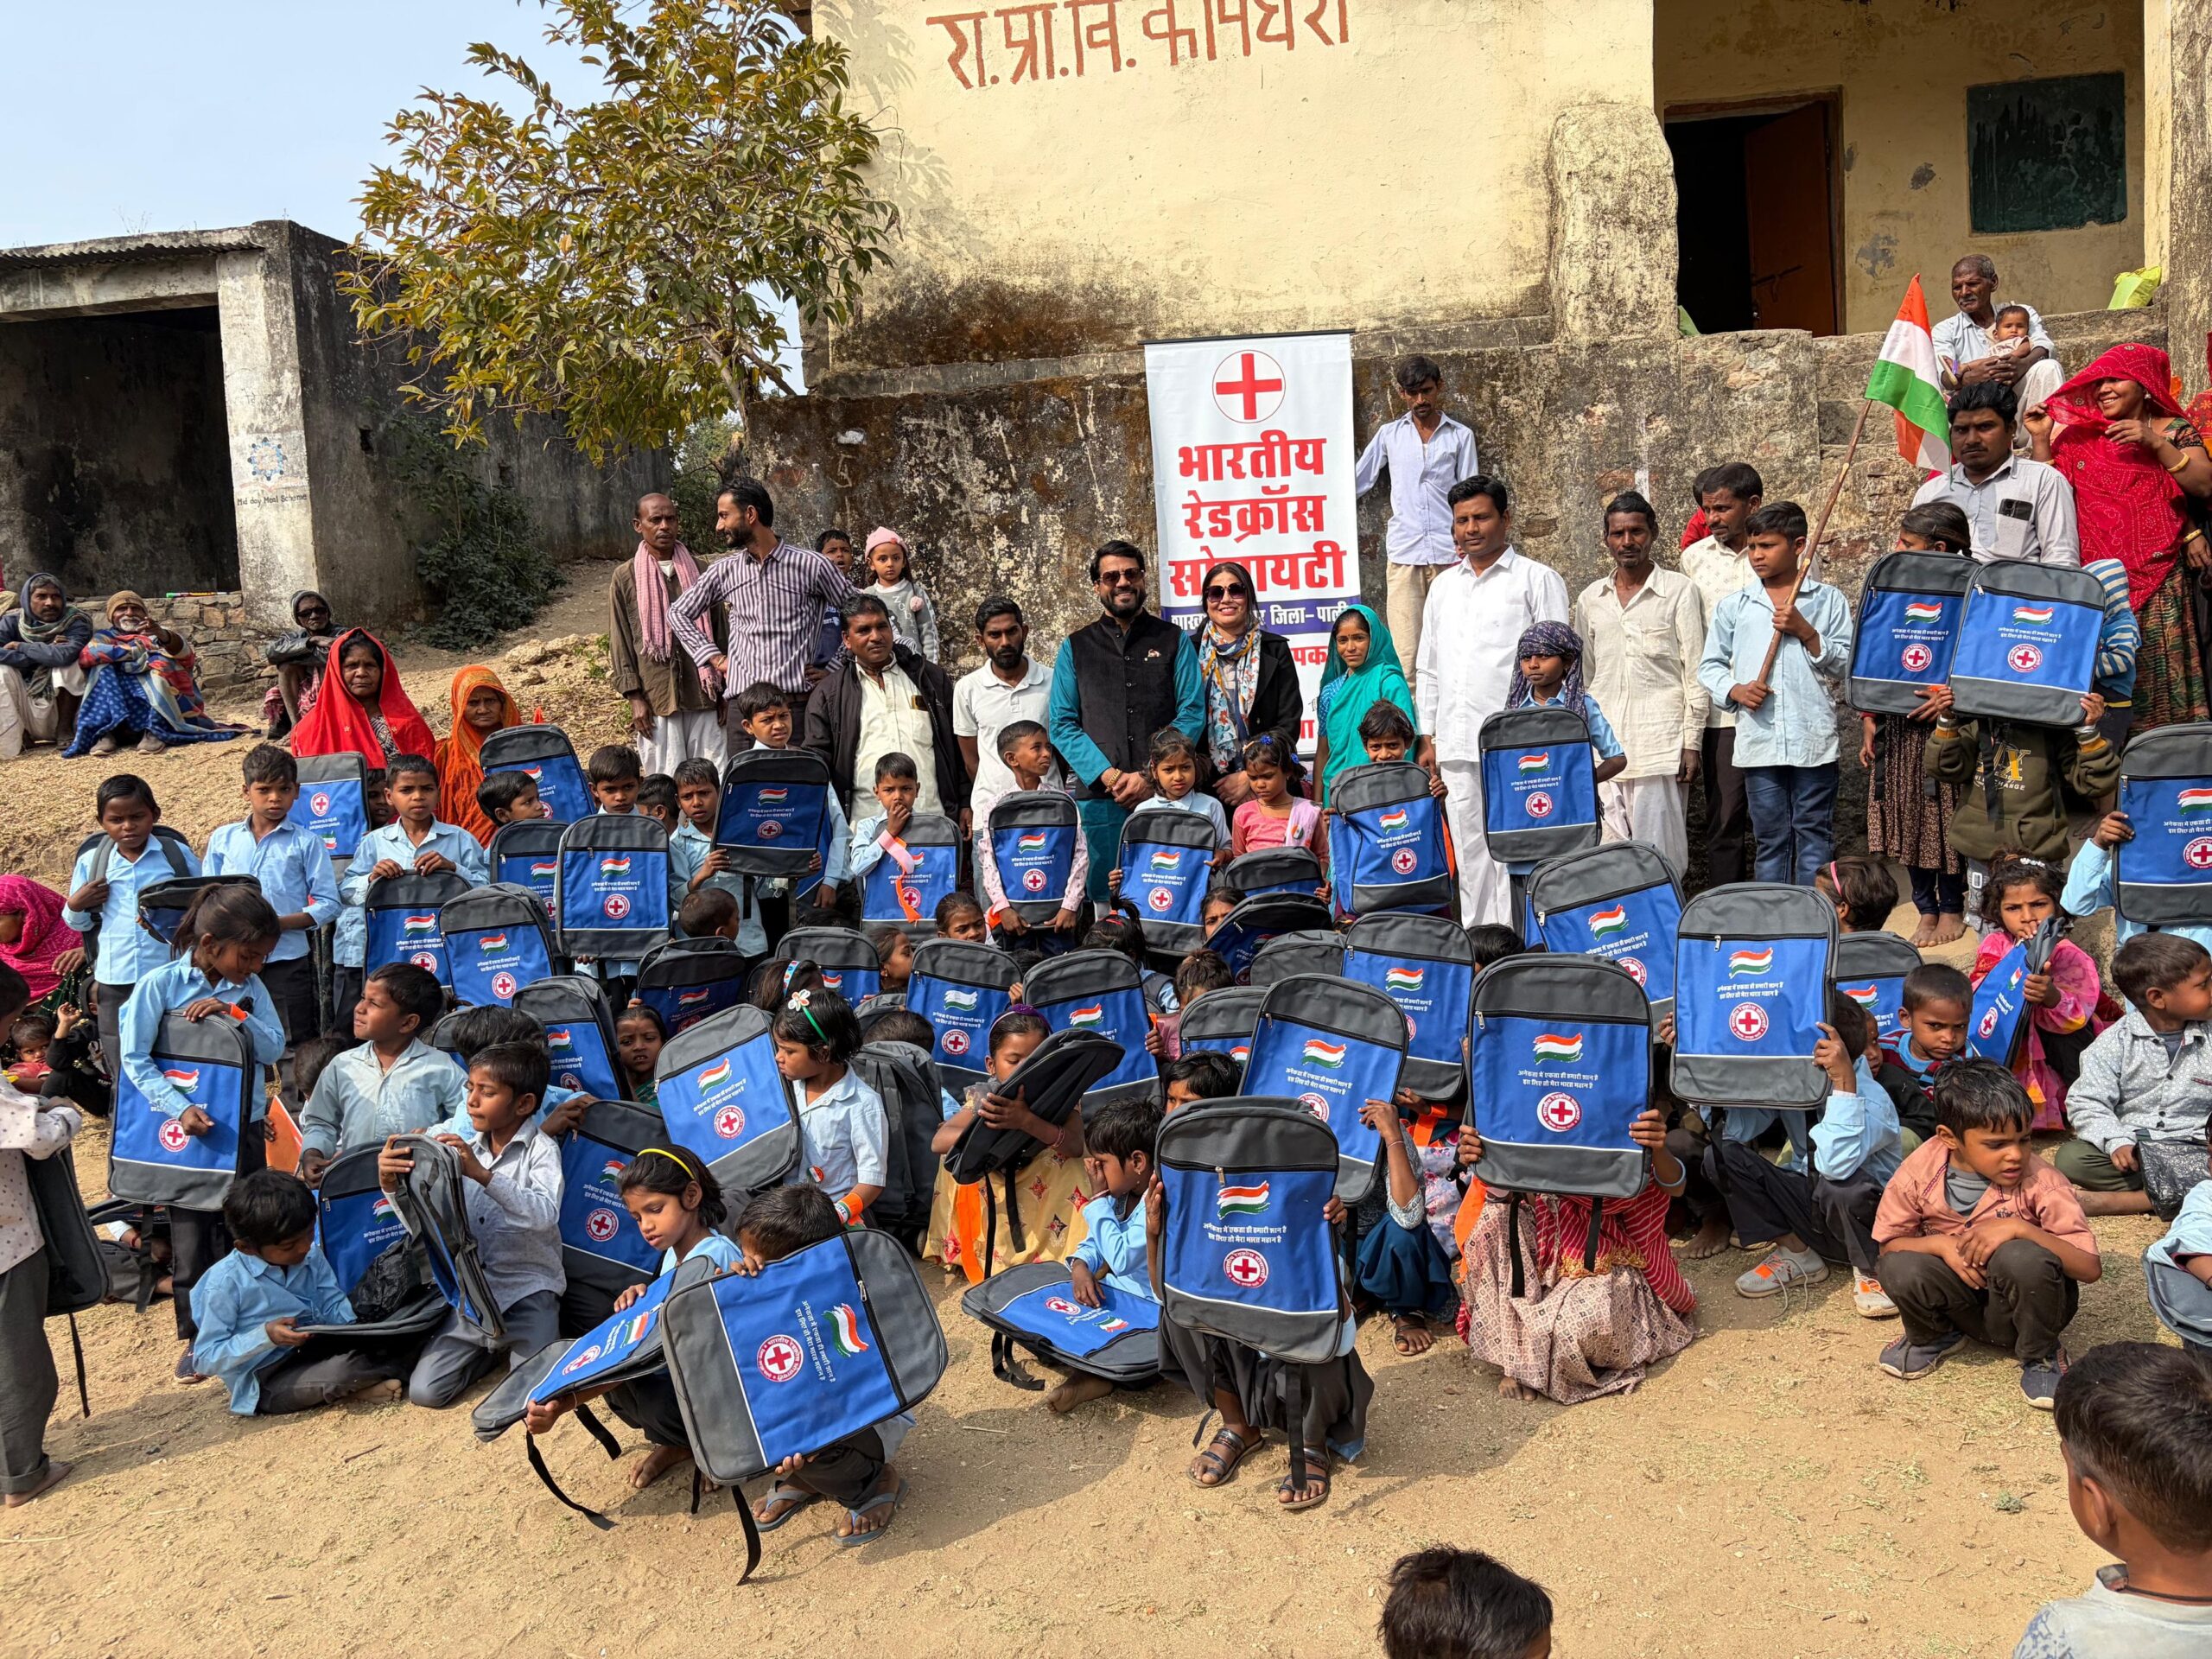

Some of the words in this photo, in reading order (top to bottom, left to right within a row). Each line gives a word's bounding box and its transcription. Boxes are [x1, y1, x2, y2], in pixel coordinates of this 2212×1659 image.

[1179, 429, 1327, 481] भारतीय
[1182, 486, 1327, 543] रेडक्रॉस
[1168, 540, 1346, 597] सोायटी
[1171, 613, 1207, 630] शाख
